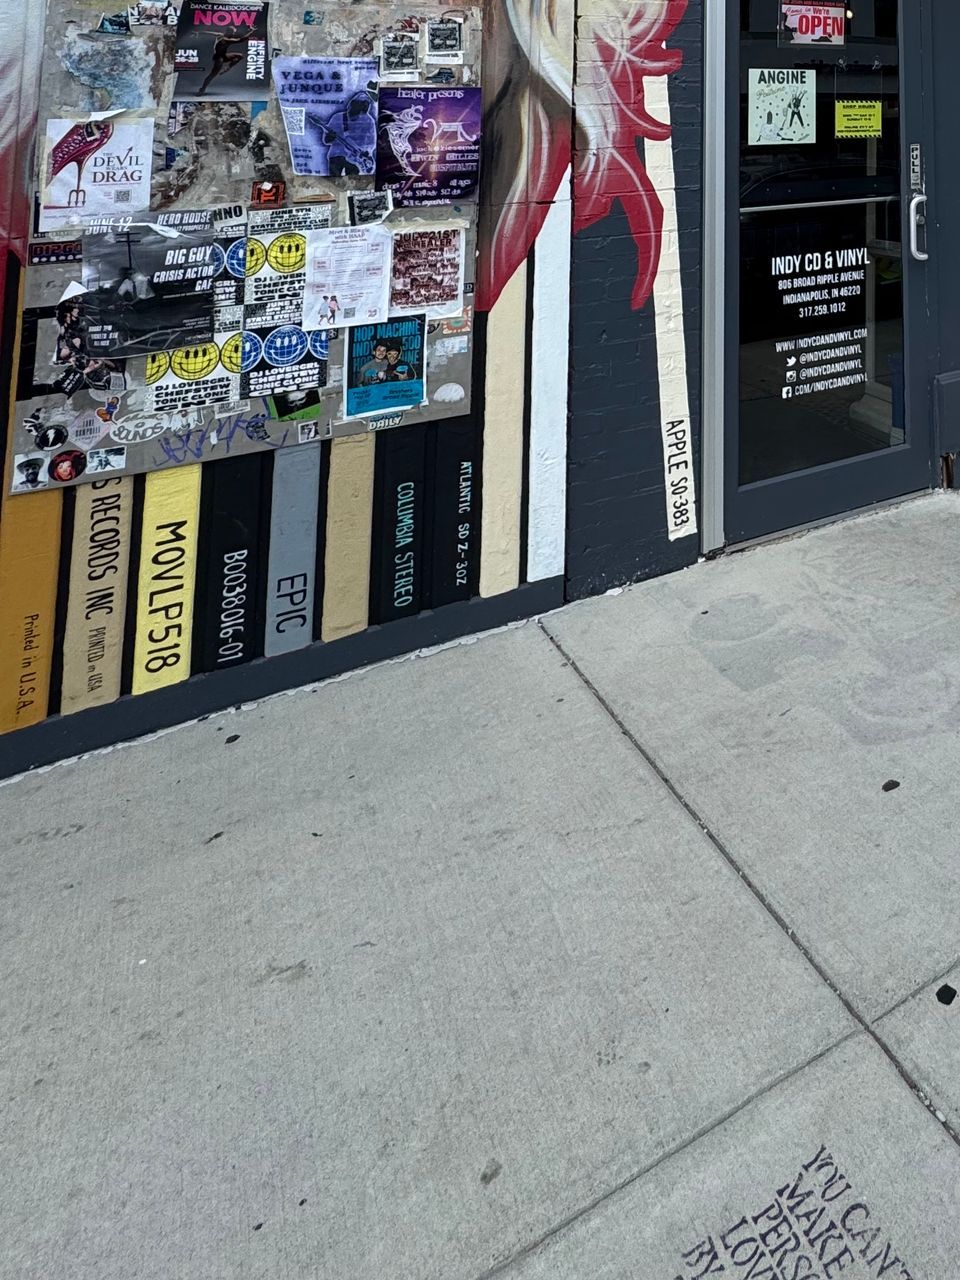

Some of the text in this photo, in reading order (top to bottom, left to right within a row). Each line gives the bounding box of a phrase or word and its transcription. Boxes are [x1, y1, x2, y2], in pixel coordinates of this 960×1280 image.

[193, 9, 257, 26] NOW
[798, 14, 844, 36] OPEN
[175, 49, 198, 57] JUN
[246, 40, 258, 80] ENGINE
[281, 71, 325, 81] VEGA
[757, 70, 806, 84] ANGINE
[280, 83, 344, 95] JUNQUE
[92, 170, 143, 183] DRAG
[156, 211, 212, 226] HERO HOUSE
[165, 245, 213, 265] BIG GUY
[771, 247, 871, 276] INDY CD & VINYL
[153, 265, 214, 283] CRISIS ACTOR
[793, 270, 865, 288] BROAD RIPPLE AVENUE
[253, 286, 285, 296] TONIC
[782, 288, 839, 305] INDIANAPOLIS, IN
[798, 302, 846, 318] 317.259.1012
[354, 320, 420, 342] HOP MACHINE
[352, 335, 421, 358] INDY 500
[249, 368, 320, 385] CHEFSTEW
[264, 361, 320, 376] LOVERGRL
[154, 382, 231, 398] CHEFSTEW
[155, 376, 232, 392] DJ LOVERGRL
[249, 374, 320, 391] TONIC CLONIC
[154, 389, 231, 406] TONIC CLONIC
[665, 419, 690, 529] APPLE SO-383
[458, 461, 472, 542] ATLANTIC SD
[87, 492, 122, 583] RECORDS
[393, 481, 415, 608] COLUMBIA STEREO
[84, 585, 114, 621] INC
[145, 520, 188, 675] MOVLP518
[275, 572, 308, 635] EPIC
[89, 626, 107, 663] PRINTED
[15, 612, 40, 717] Printed in U.S.A.
[87, 674, 104, 694] USA
[802, 1144, 852, 1203] YOU
[776, 1172, 855, 1279] MAKE
